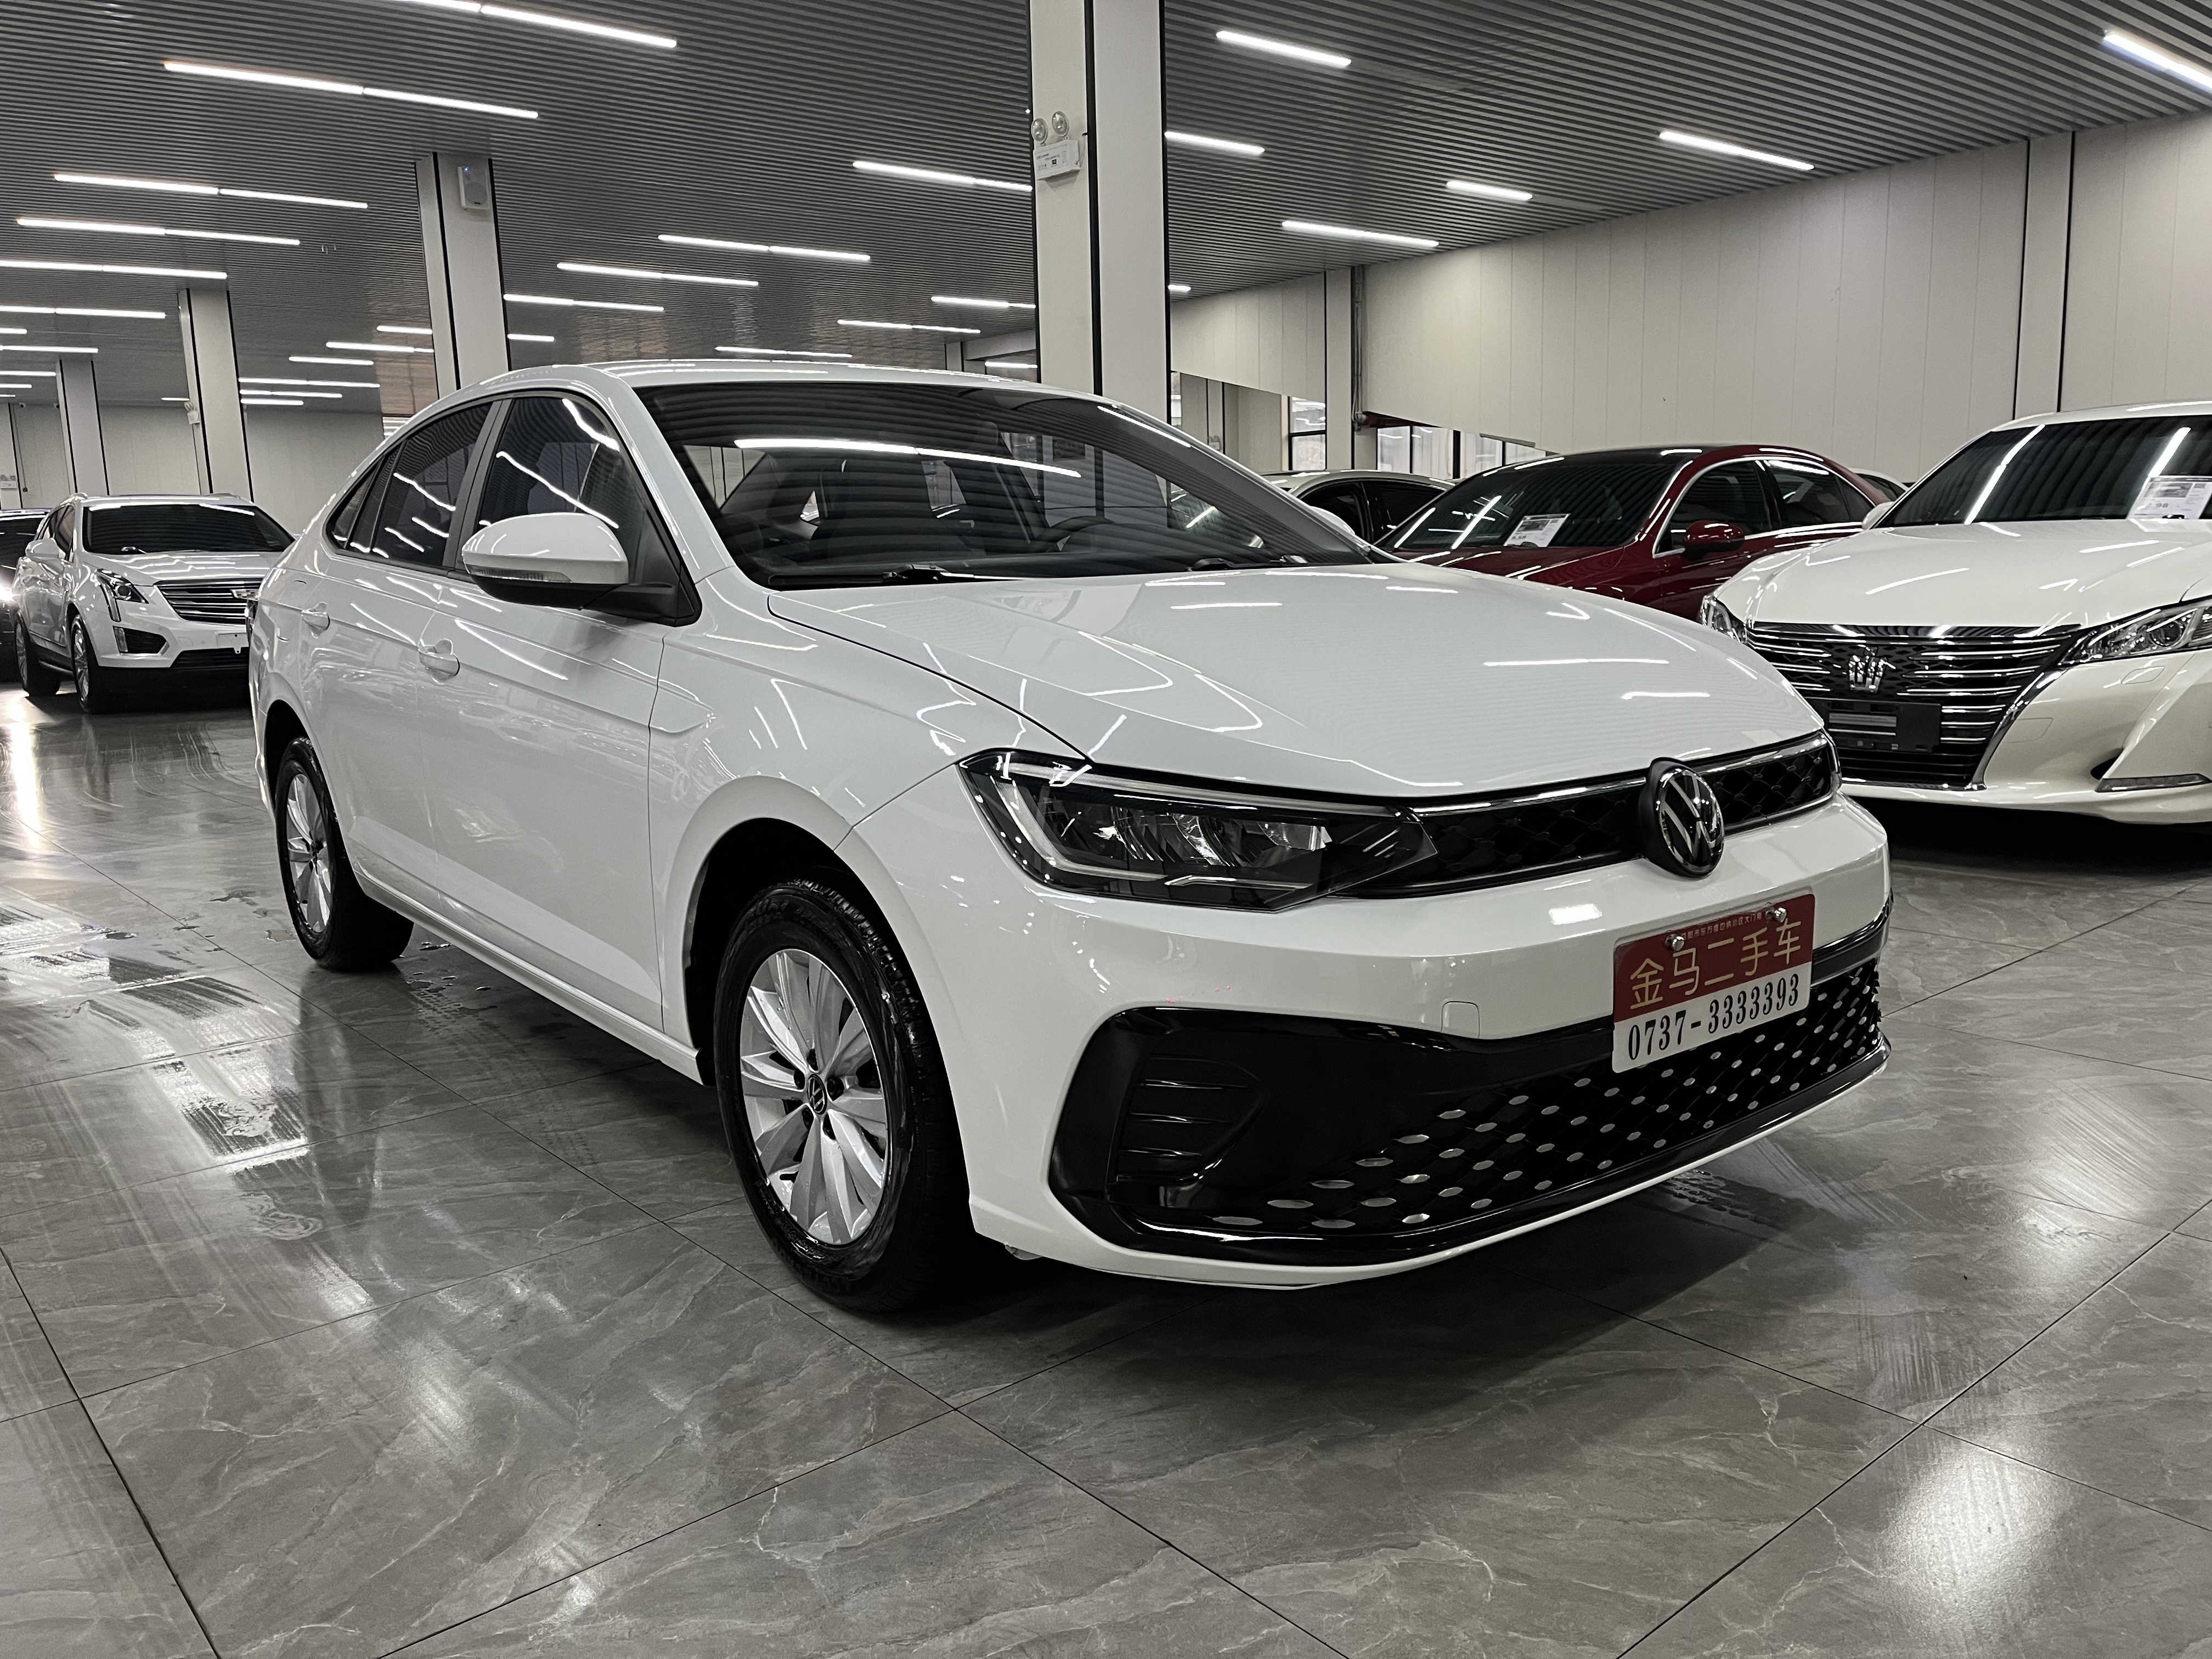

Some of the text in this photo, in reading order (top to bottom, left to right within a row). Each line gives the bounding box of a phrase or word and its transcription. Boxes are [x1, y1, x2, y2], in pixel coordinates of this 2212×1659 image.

[1630, 918, 1802, 1010] 金马二手车
[1628, 973, 1799, 1060] 0737-3333393
